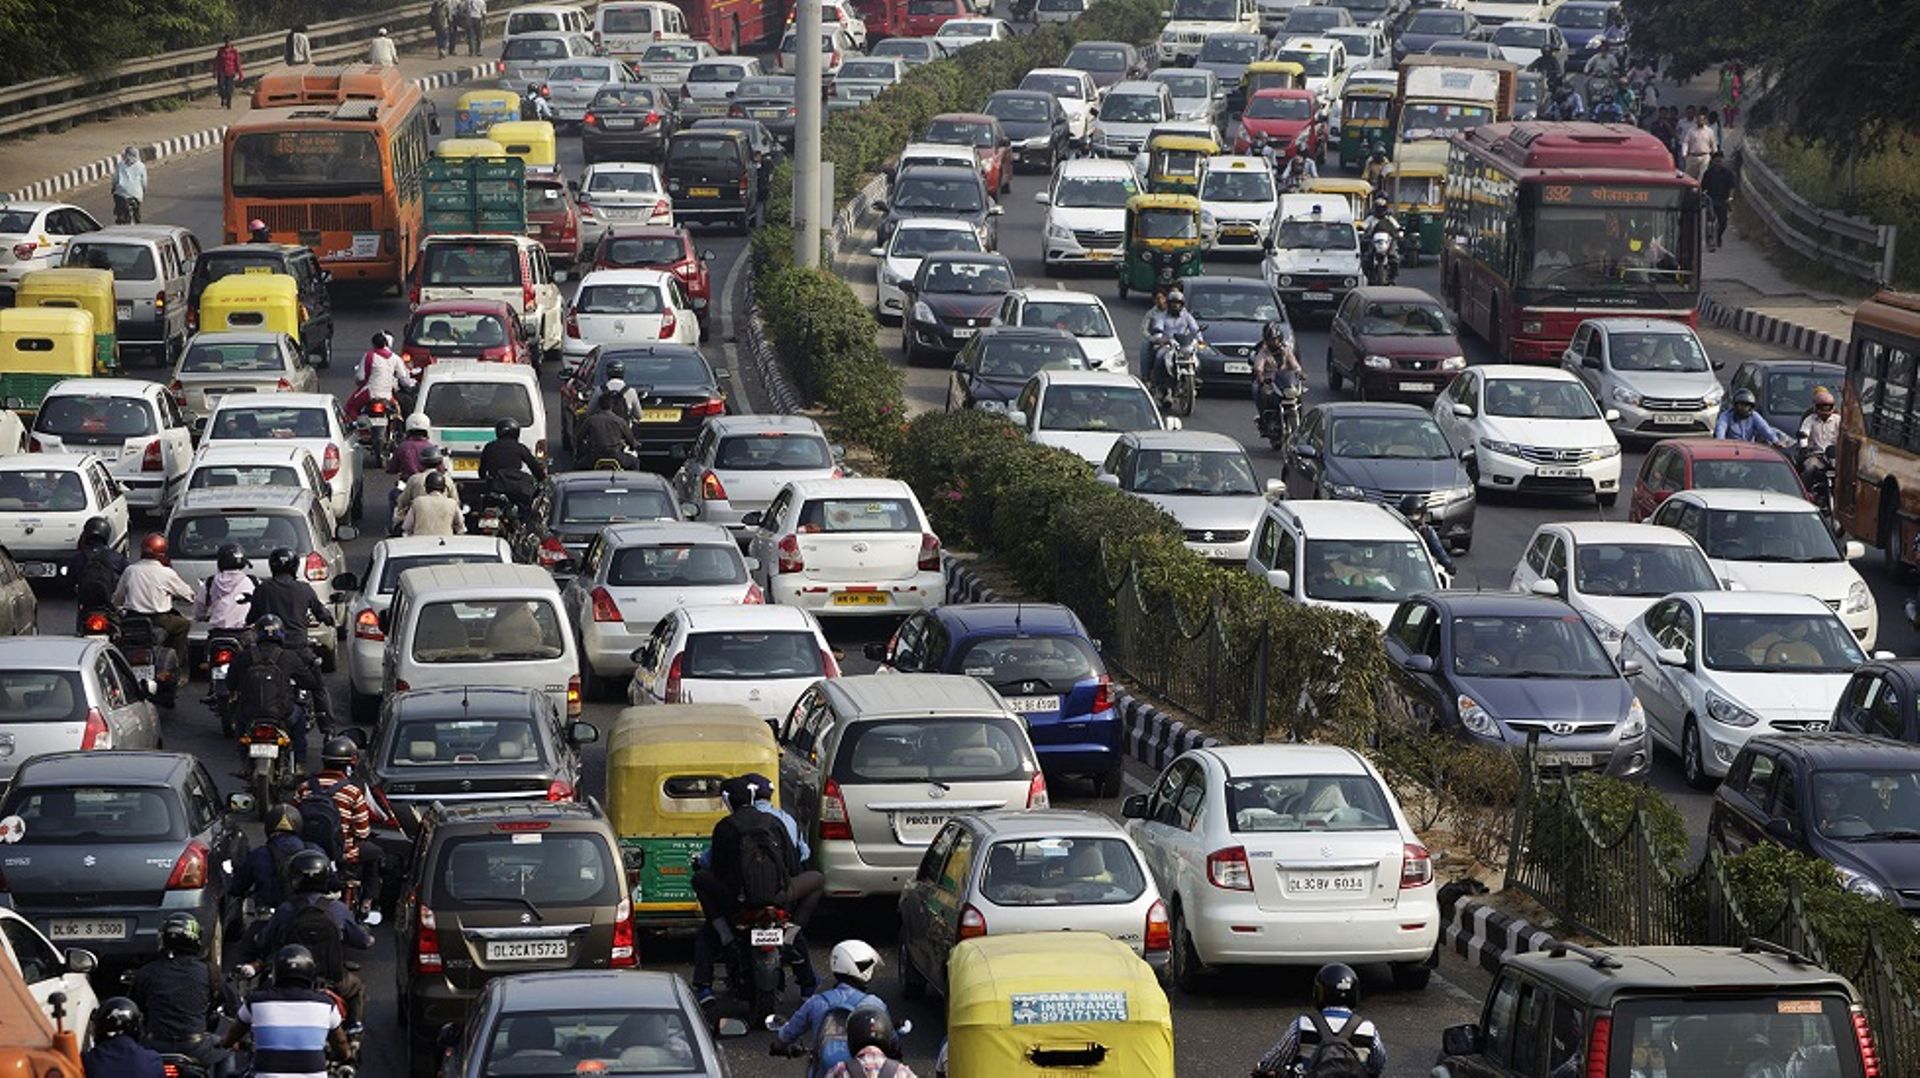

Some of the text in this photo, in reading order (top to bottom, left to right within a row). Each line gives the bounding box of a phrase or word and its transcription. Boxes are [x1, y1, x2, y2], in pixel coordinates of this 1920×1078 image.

[1545, 185, 1572, 201] 392
[1039, 993, 1068, 1001] CAR
[1041, 1000, 1124, 1012] INSURANCE
